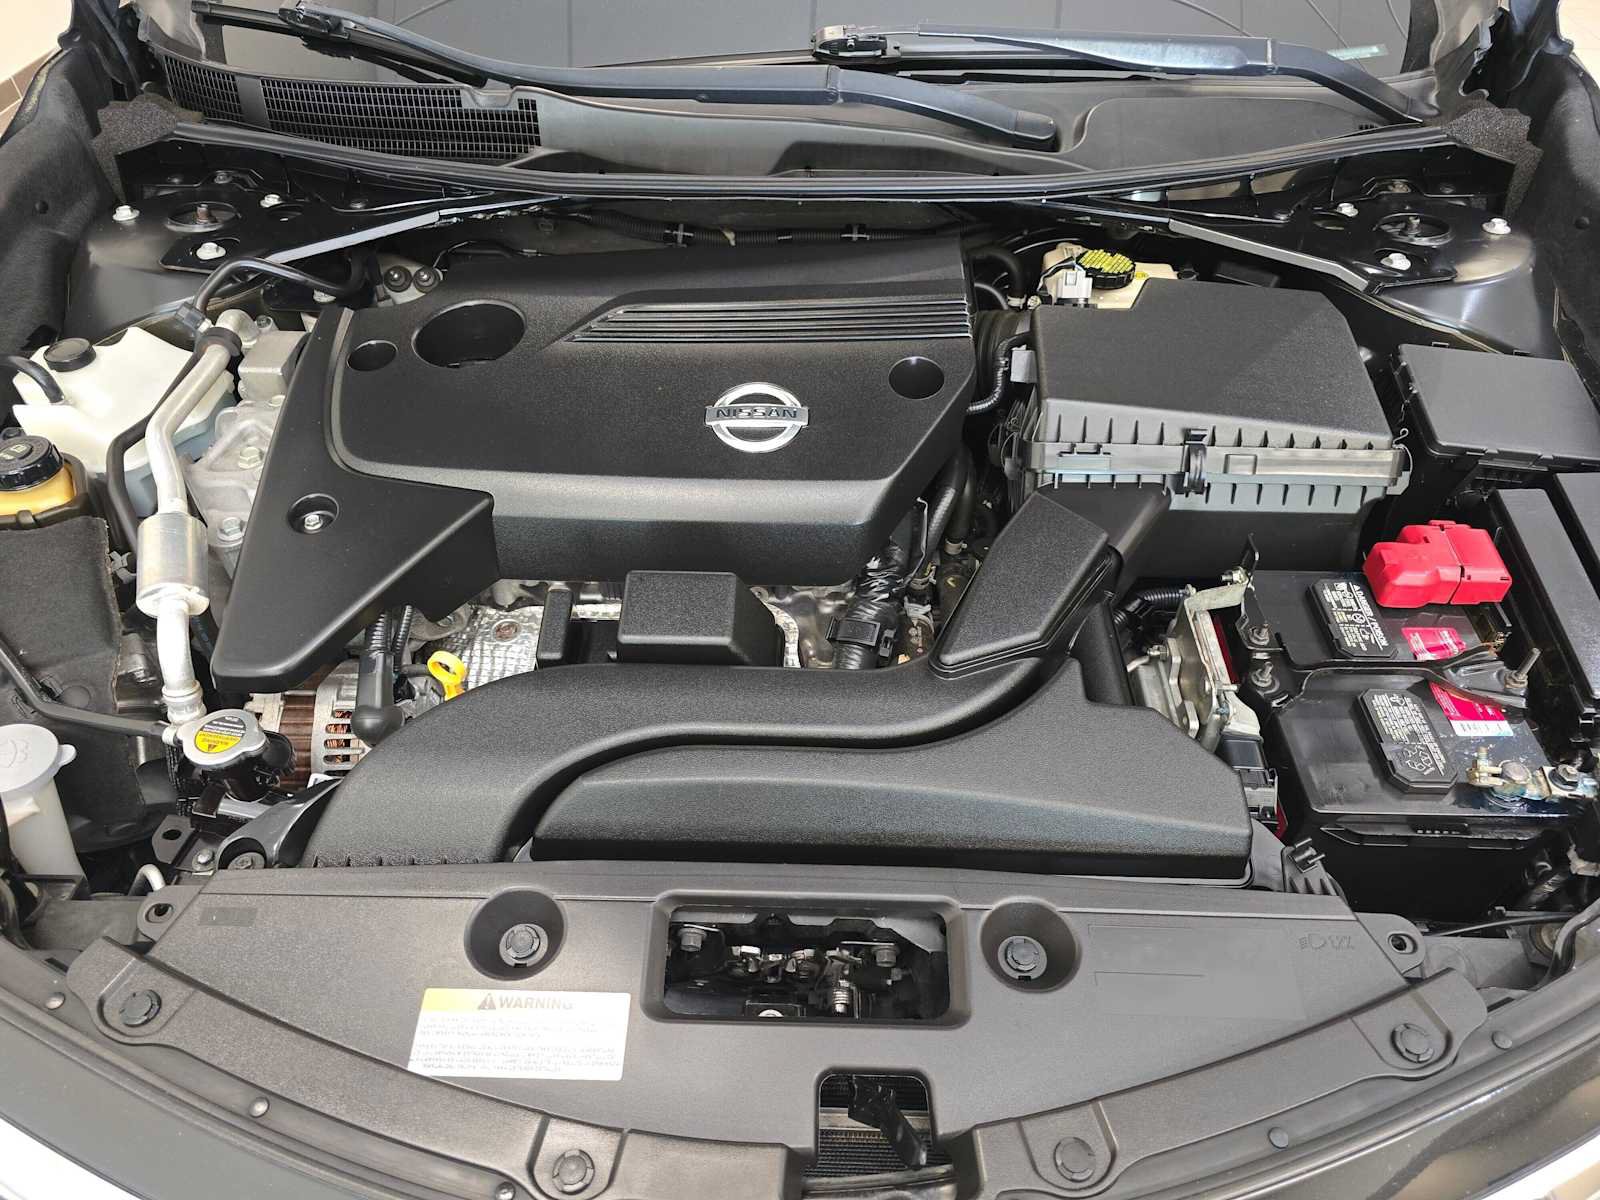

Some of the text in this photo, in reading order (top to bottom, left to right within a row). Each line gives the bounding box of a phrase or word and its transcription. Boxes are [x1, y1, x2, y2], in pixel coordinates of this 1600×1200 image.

[716, 406, 797, 419] NISSAN
[1371, 621, 1389, 646] POISON
[499, 996, 574, 1011] WARNING
